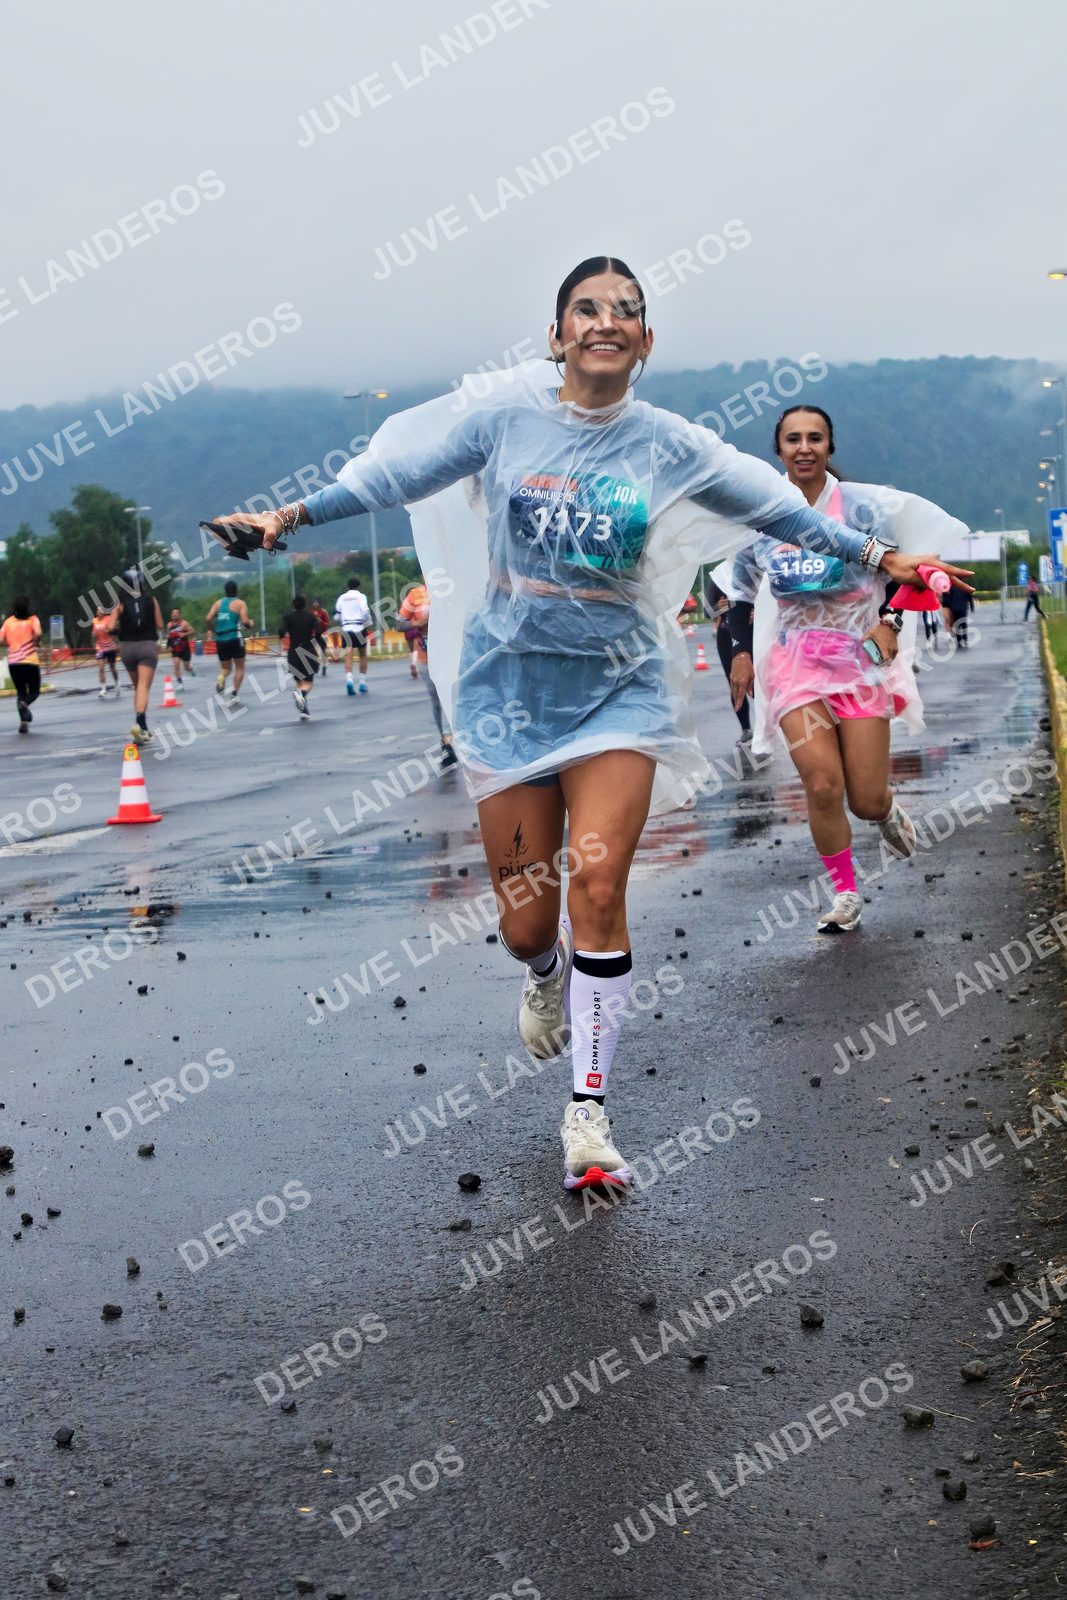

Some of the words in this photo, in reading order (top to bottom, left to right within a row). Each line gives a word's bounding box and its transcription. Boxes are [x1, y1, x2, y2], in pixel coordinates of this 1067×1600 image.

[614, 485, 639, 505] 10K
[534, 506, 612, 541] 1173
[781, 558, 825, 578] 1169
[591, 990, 601, 1071] COMPRESSPORT
